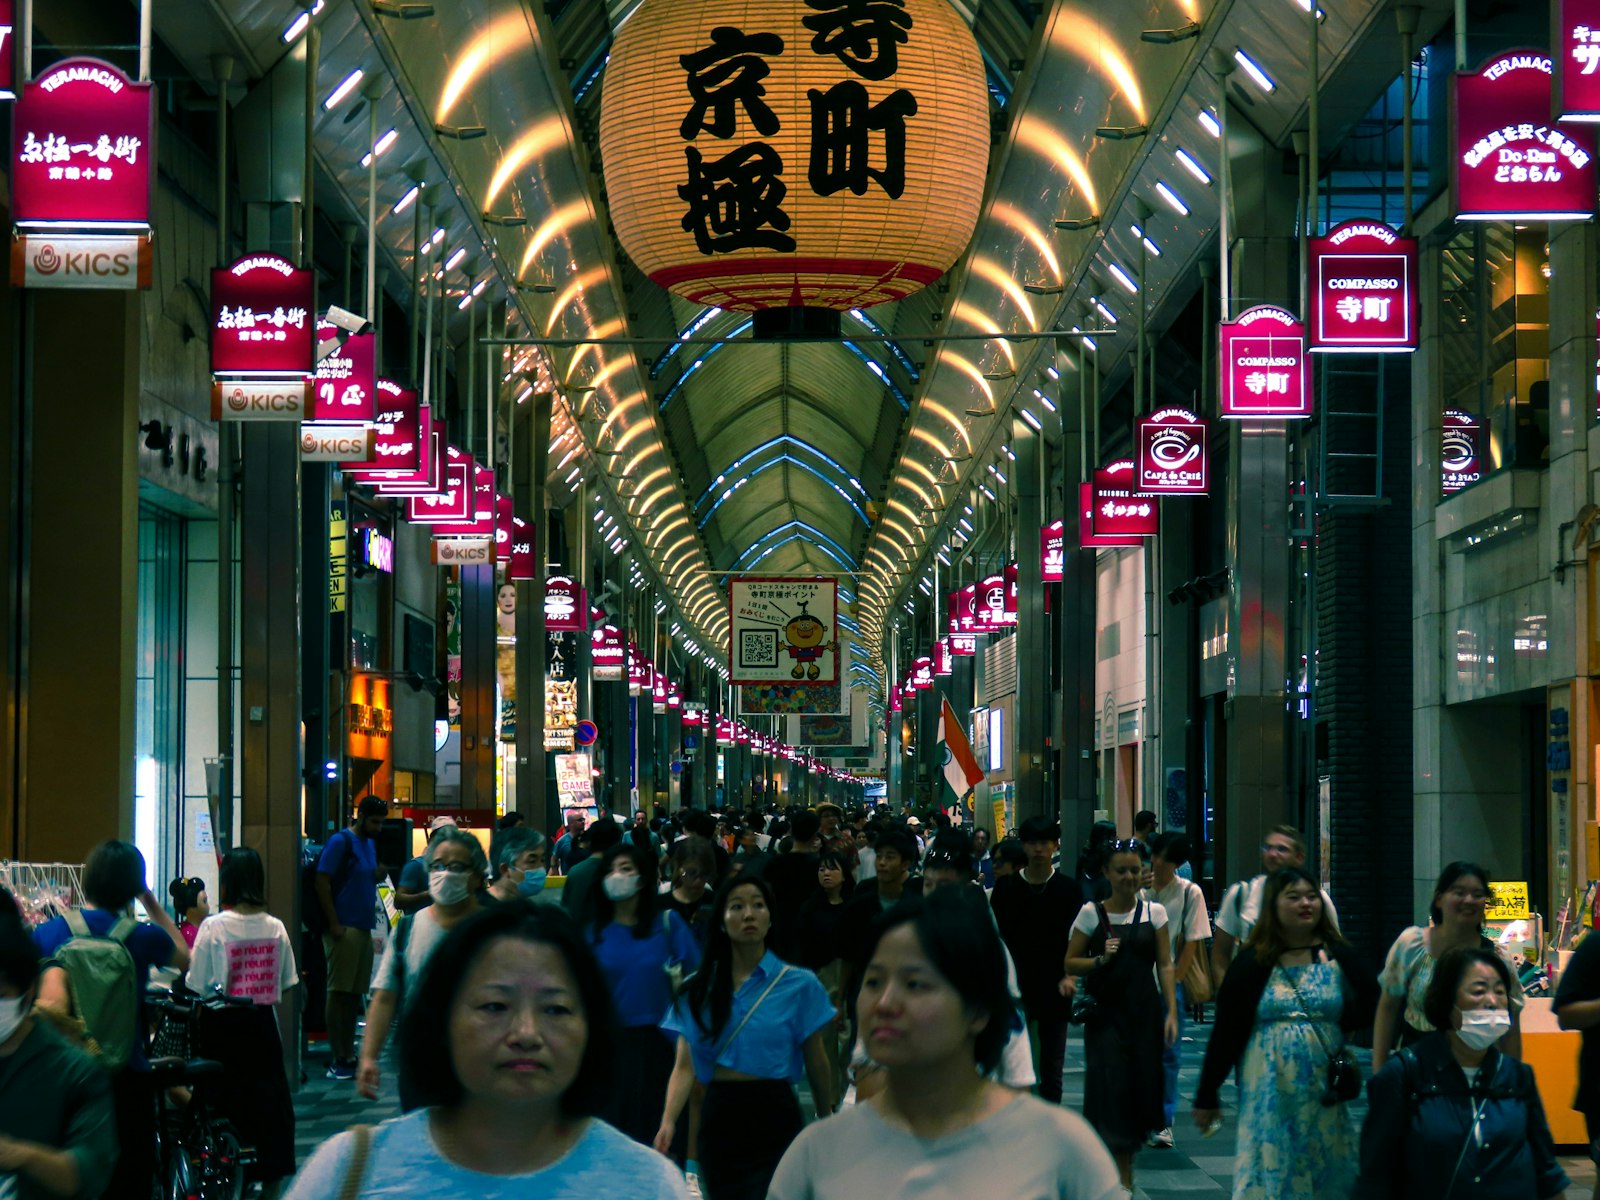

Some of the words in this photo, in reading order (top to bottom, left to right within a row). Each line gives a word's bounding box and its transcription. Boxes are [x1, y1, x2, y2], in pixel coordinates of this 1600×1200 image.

[1483, 56, 1552, 80] TERAMAC
[41, 67, 123, 93] TERAMACHI
[676, 27, 797, 254] 京極
[1494, 165, 1561, 182] どおらん
[1329, 226, 1395, 246] TERAMACHI
[65, 253, 129, 276] KICS
[232, 257, 293, 277] TERAMACHI
[1328, 278, 1398, 290] COMPASSO
[1336, 296, 1391, 323] 寺町
[1239, 310, 1294, 328] TERAMACHI
[1237, 357, 1296, 367] COMPASSO
[1244, 373, 1290, 395] 寺町
[252, 395, 298, 412] KICS
[1151, 409, 1197, 424] TERAMACHI
[320, 439, 362, 455] KICS
[455, 548, 485, 559] KICS
[751, 591, 816, 599] 寺町京極ポイント
[562, 781, 590, 790] GAME
[427, 815, 472, 823] RAL
